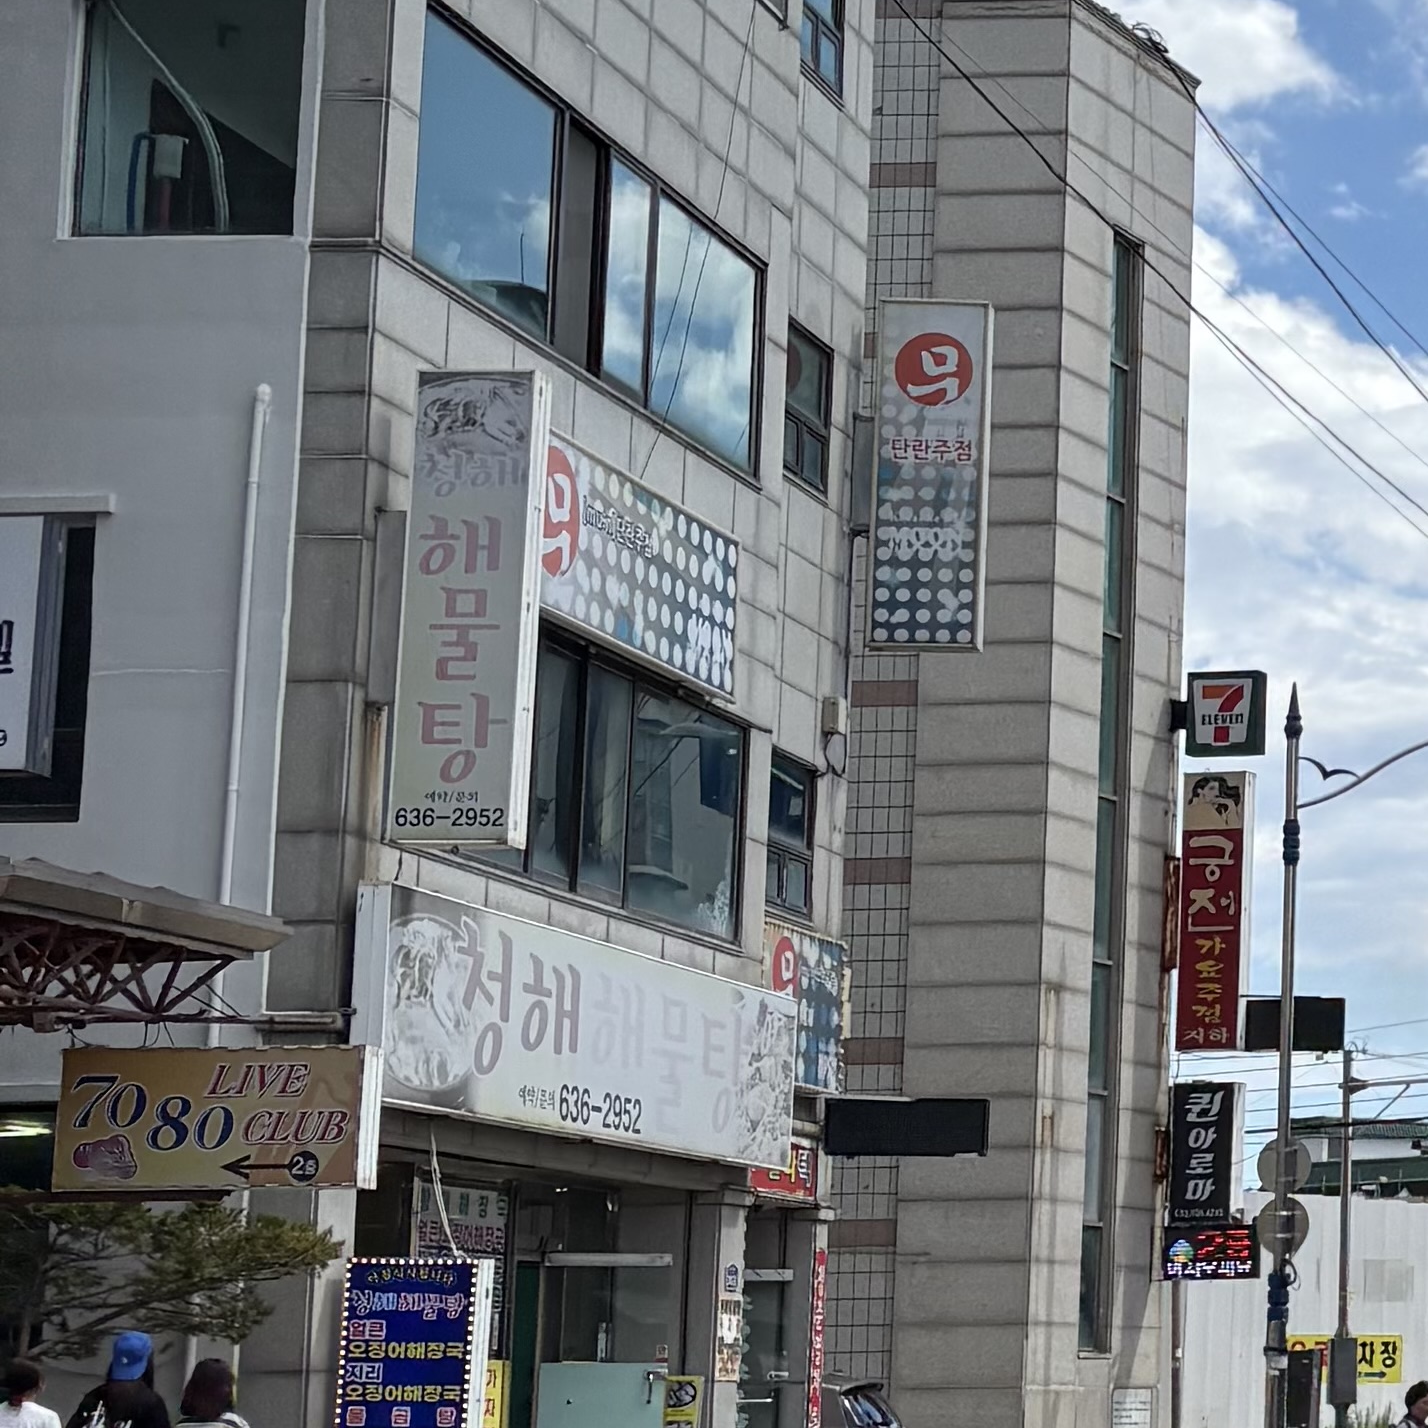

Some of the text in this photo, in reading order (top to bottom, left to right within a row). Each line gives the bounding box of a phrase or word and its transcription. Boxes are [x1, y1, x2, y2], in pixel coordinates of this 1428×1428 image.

[418, 515, 508, 784] 해물탕
[1202, 684, 1244, 743] 7
[394, 807, 505, 828] 636-2952
[1188, 836, 1235, 932] 궁전
[1191, 936, 1226, 1023] 가요주점
[1183, 1027, 1230, 1044] 지하
[203, 1063, 310, 1099] LIVE
[241, 1108, 350, 1145] CLUB
[559, 1083, 642, 1134] 636-2952
[1184, 1090, 1225, 1202] 퀸아로마
[348, 1341, 464, 1359] 오징어해장국
[345, 1362, 383, 1383] 지리
[345, 1384, 460, 1402] 오징어해장국
